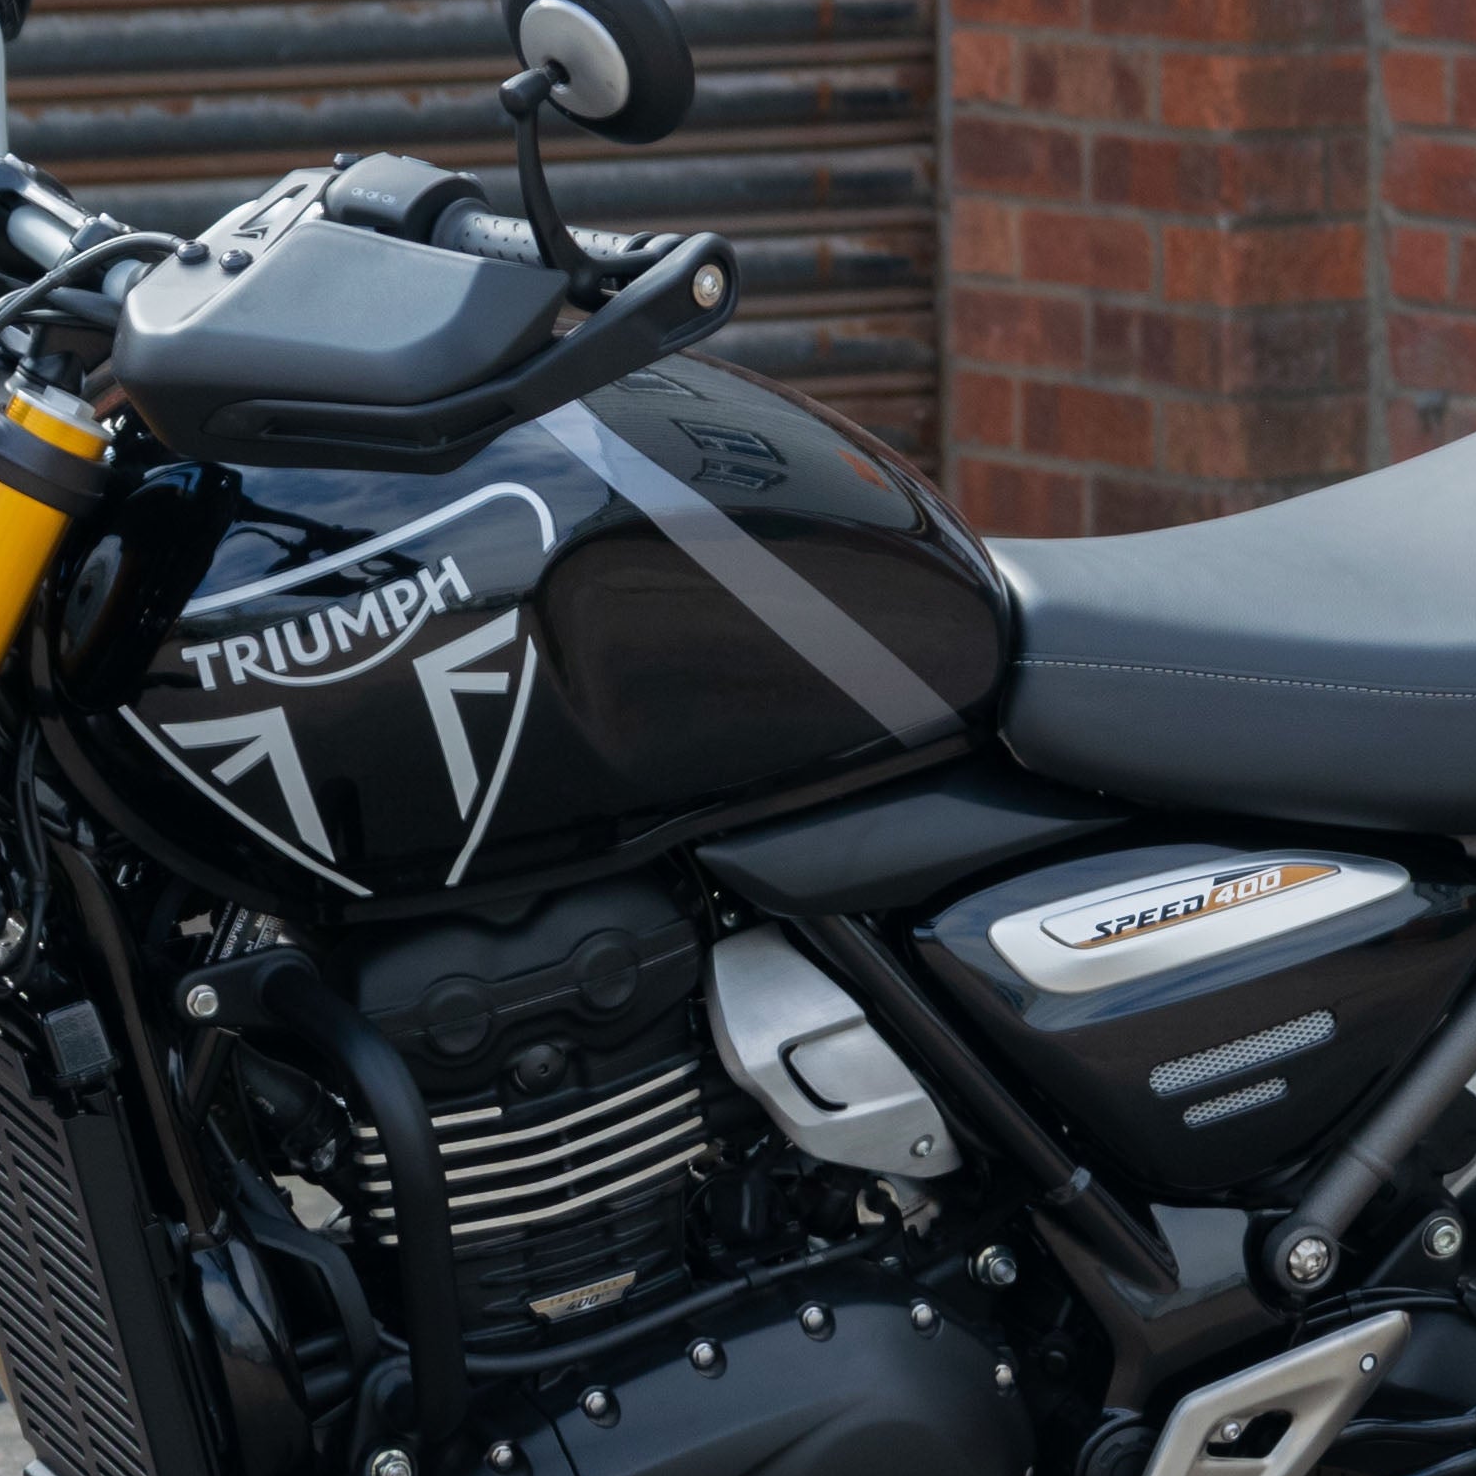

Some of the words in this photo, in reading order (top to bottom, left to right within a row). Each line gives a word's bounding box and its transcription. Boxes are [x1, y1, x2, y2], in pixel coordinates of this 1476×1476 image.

[182, 556, 472, 691] TRIUMPH
[1091, 894, 1205, 941] SPEED
[1214, 870, 1282, 904] 400
